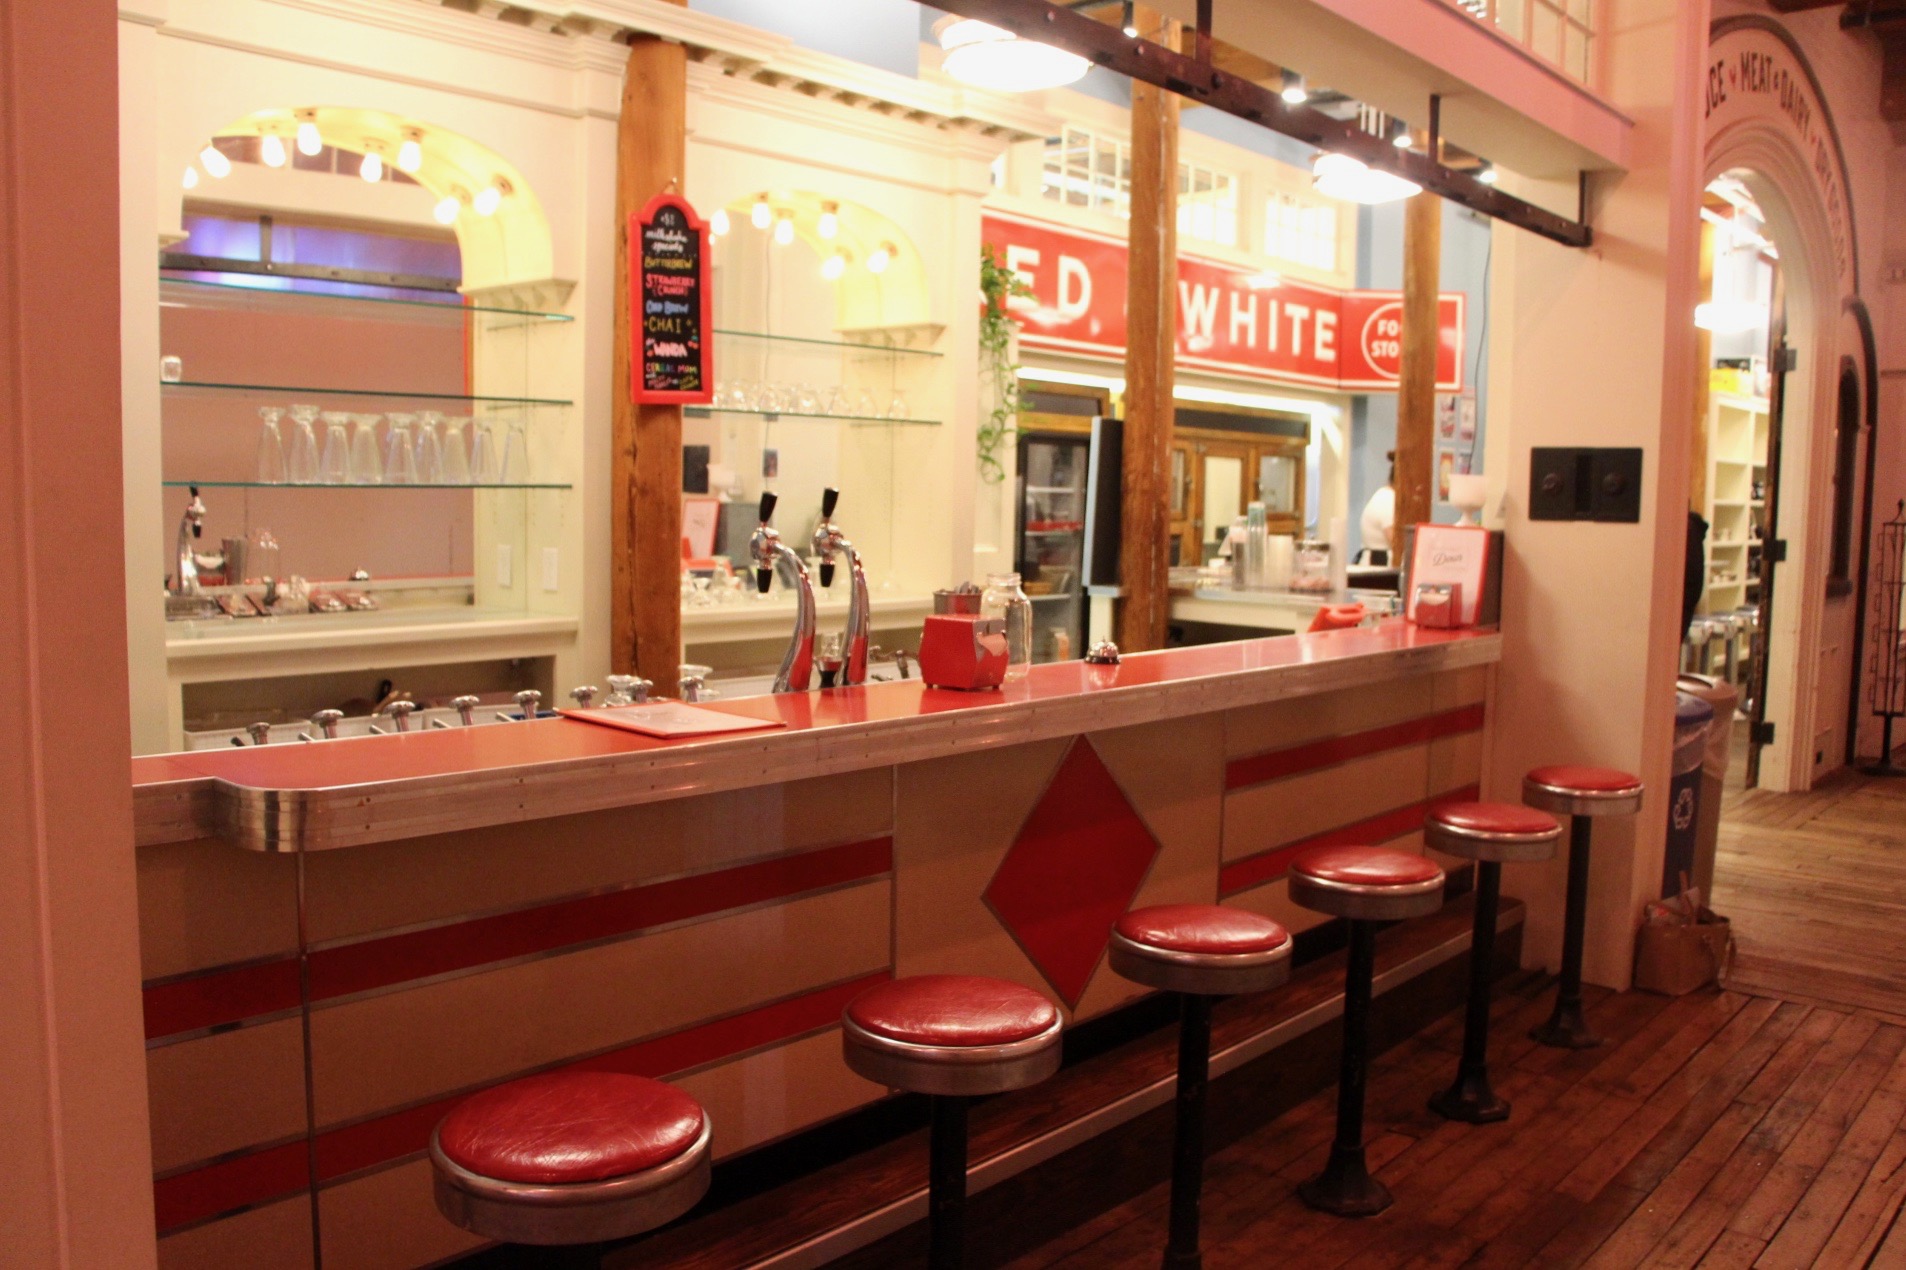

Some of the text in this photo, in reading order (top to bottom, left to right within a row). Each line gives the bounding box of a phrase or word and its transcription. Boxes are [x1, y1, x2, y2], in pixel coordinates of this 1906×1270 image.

[1740, 51, 1773, 94] MEAT
[1780, 68, 1811, 141] DAIRY
[1006, 244, 1338, 361] ED WHITE
[649, 316, 682, 334] CHAI
[1377, 319, 1399, 337] FO
[1371, 340, 1400, 358] STO
